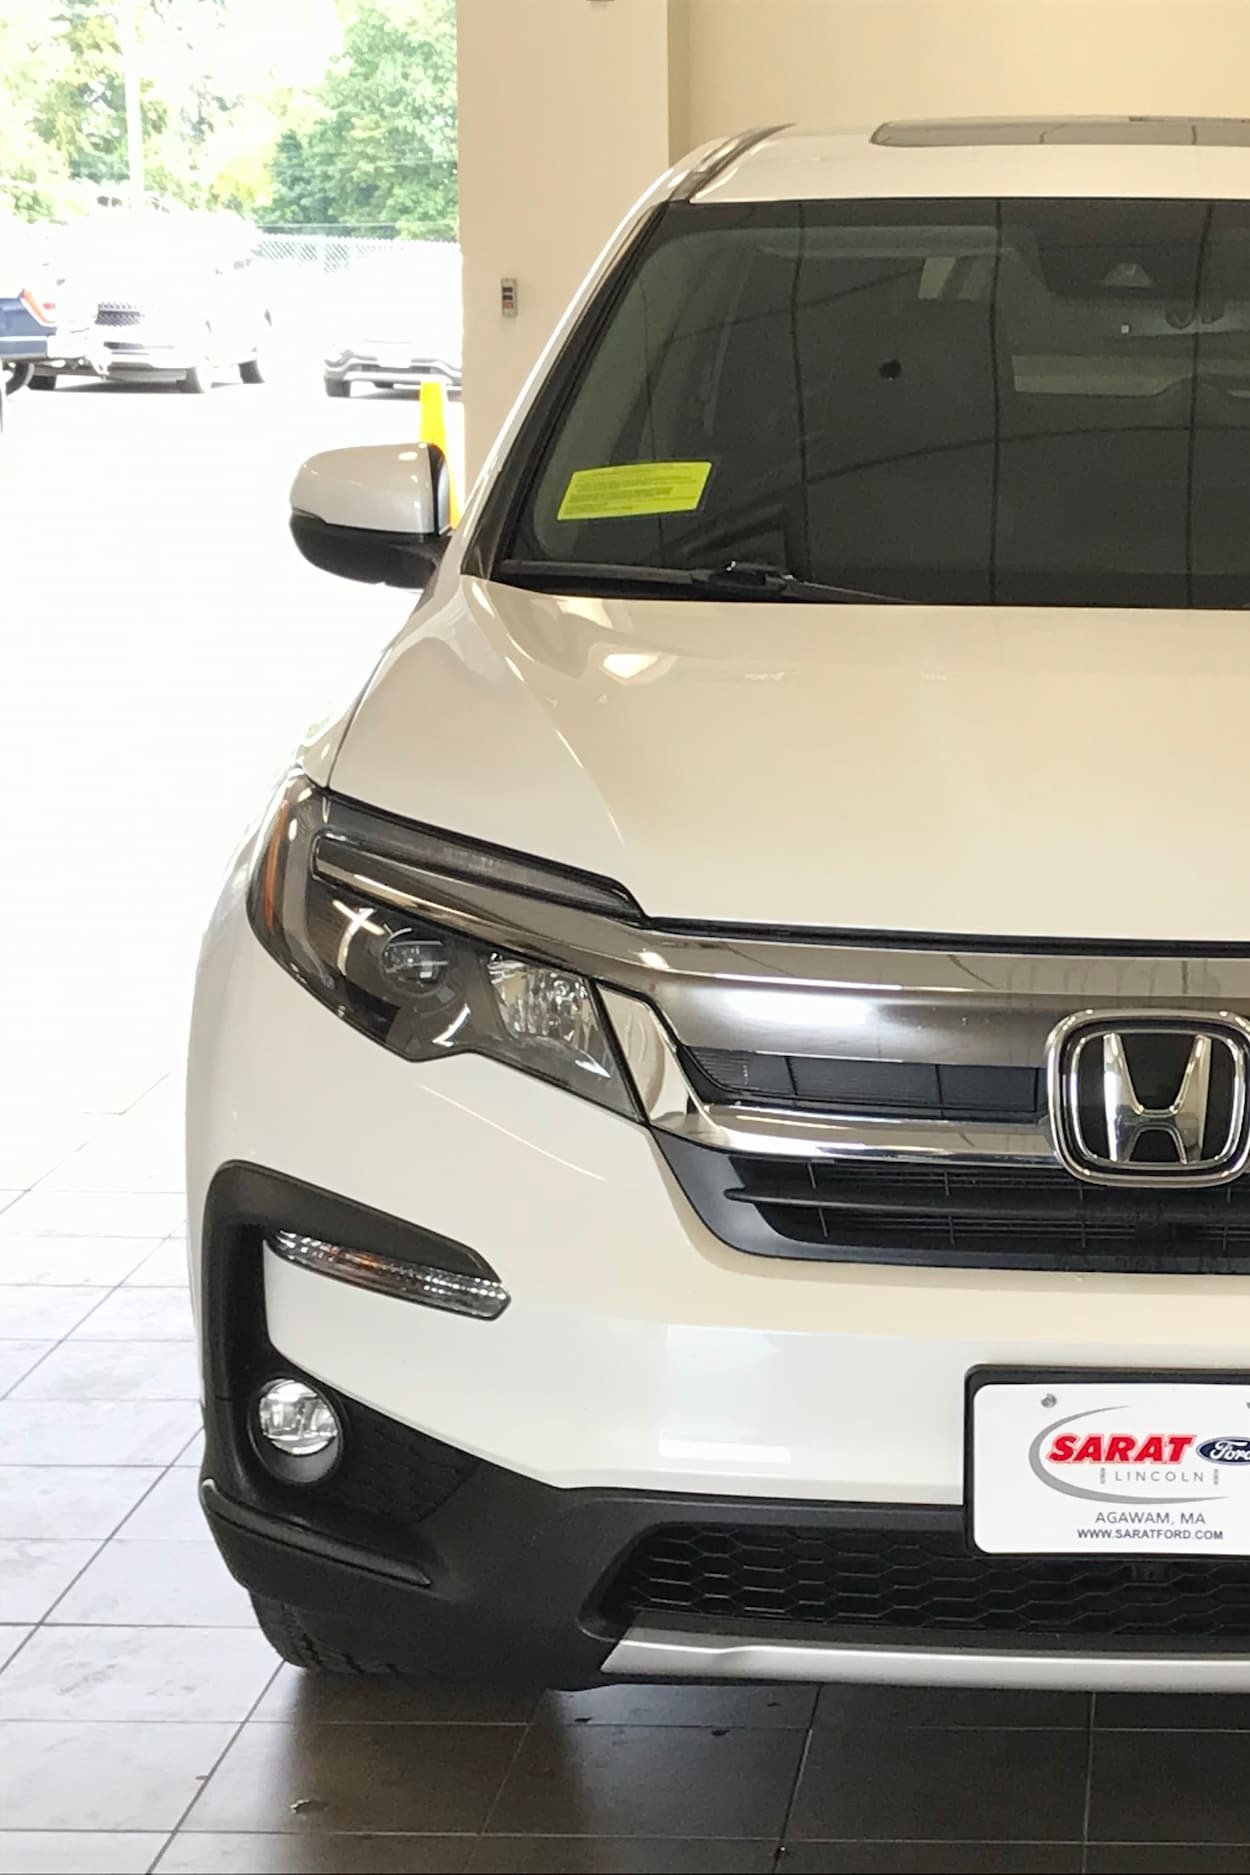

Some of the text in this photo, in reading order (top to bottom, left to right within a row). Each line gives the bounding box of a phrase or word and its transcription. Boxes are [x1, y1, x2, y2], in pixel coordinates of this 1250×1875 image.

[1048, 1434, 1196, 1464] SARAT
[1114, 1470, 1205, 1482] LINCOLN
[1095, 1511, 1206, 1526] AGAWAM, MA
[1077, 1528, 1224, 1541] WWW.SARATFORD.COM
